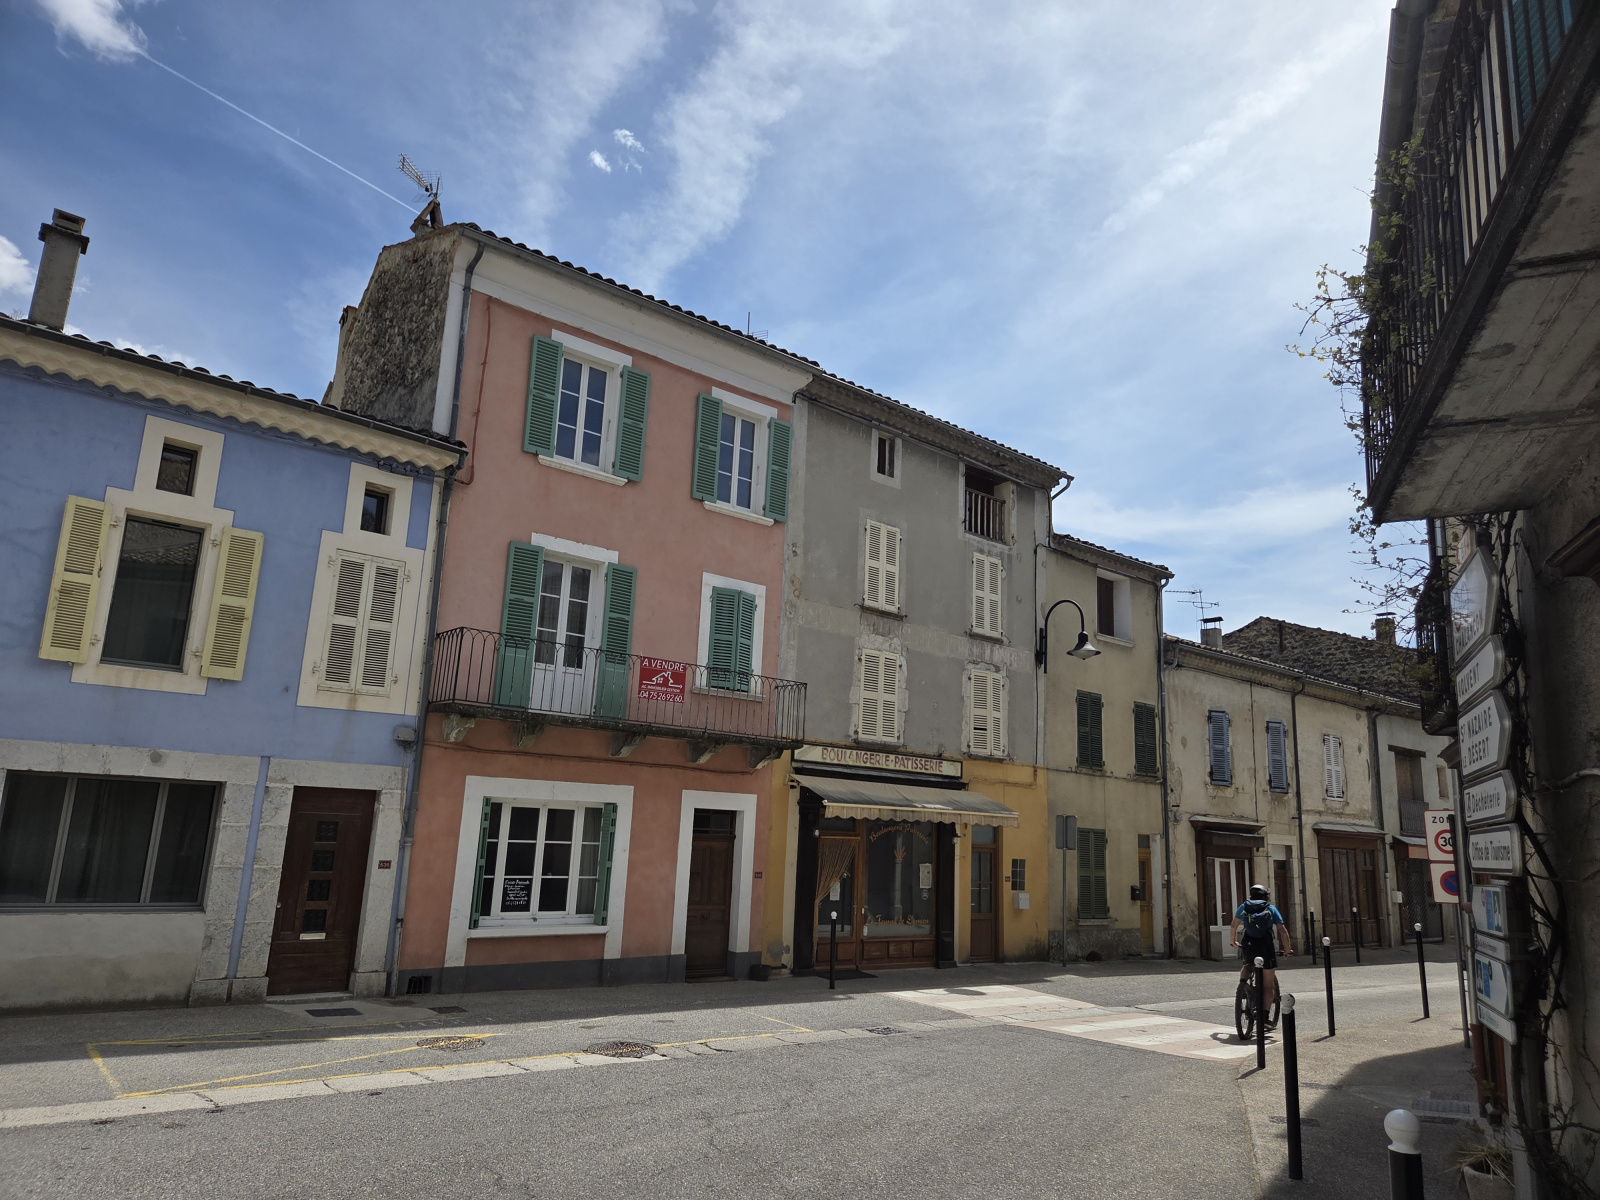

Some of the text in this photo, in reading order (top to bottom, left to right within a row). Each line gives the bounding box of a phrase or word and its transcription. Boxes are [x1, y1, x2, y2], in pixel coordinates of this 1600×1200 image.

[643, 658, 685, 672] A VENDRE
[1458, 662, 1480, 699] VOLVENT
[640, 690, 649, 698] 04
[649, 691, 658, 699] 75
[657, 692, 666, 701] 26
[666, 693, 675, 702] 92
[1467, 705, 1493, 739] NAZAIRE
[1468, 736, 1490, 766] DÉSERT
[1431, 816, 1450, 824] ZO
[1440, 836, 1453, 847] 30
[1472, 841, 1484, 861] Office
[1490, 840, 1511, 861] Tourisme
